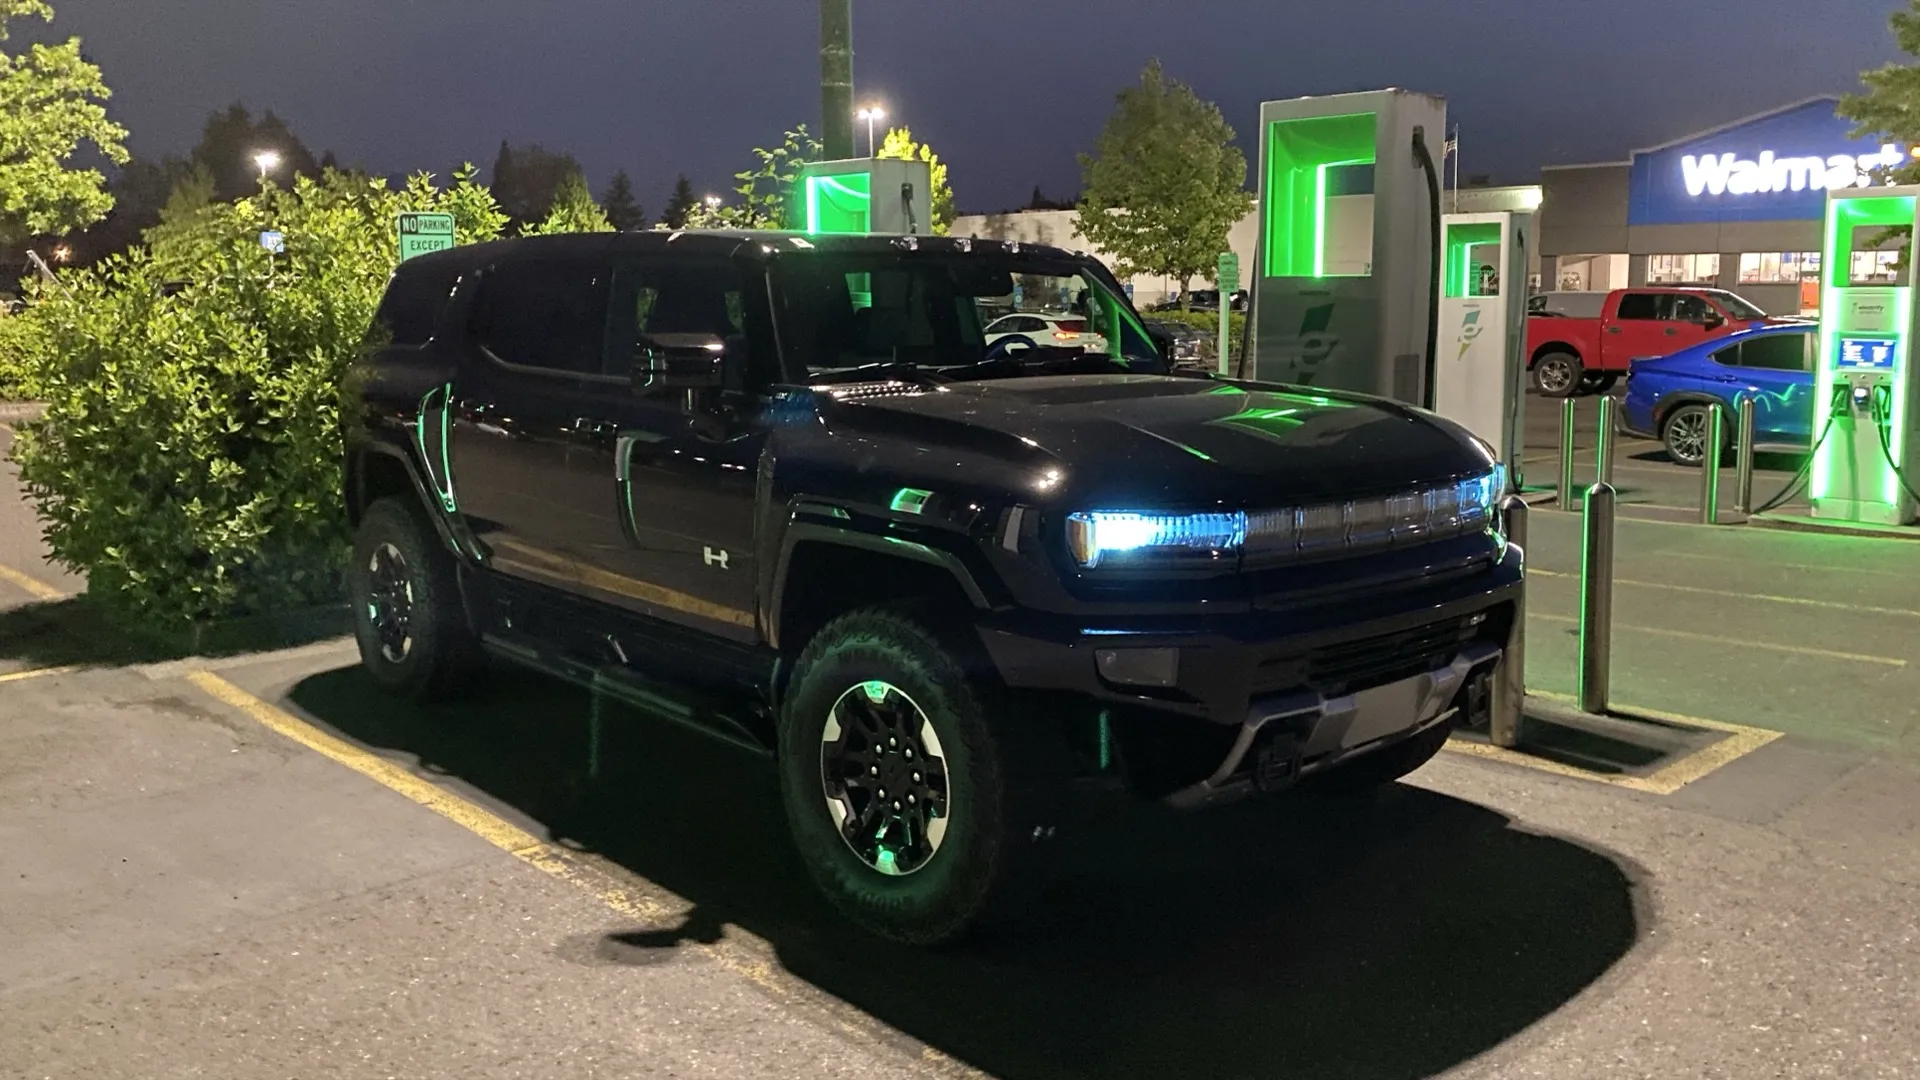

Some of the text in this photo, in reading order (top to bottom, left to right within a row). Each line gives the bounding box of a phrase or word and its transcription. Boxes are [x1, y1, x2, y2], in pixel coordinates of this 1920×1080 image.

[1681, 143, 1904, 196] Walmart
[402, 217, 450, 232] NO PARKING
[410, 240, 445, 251] EXCEPT
